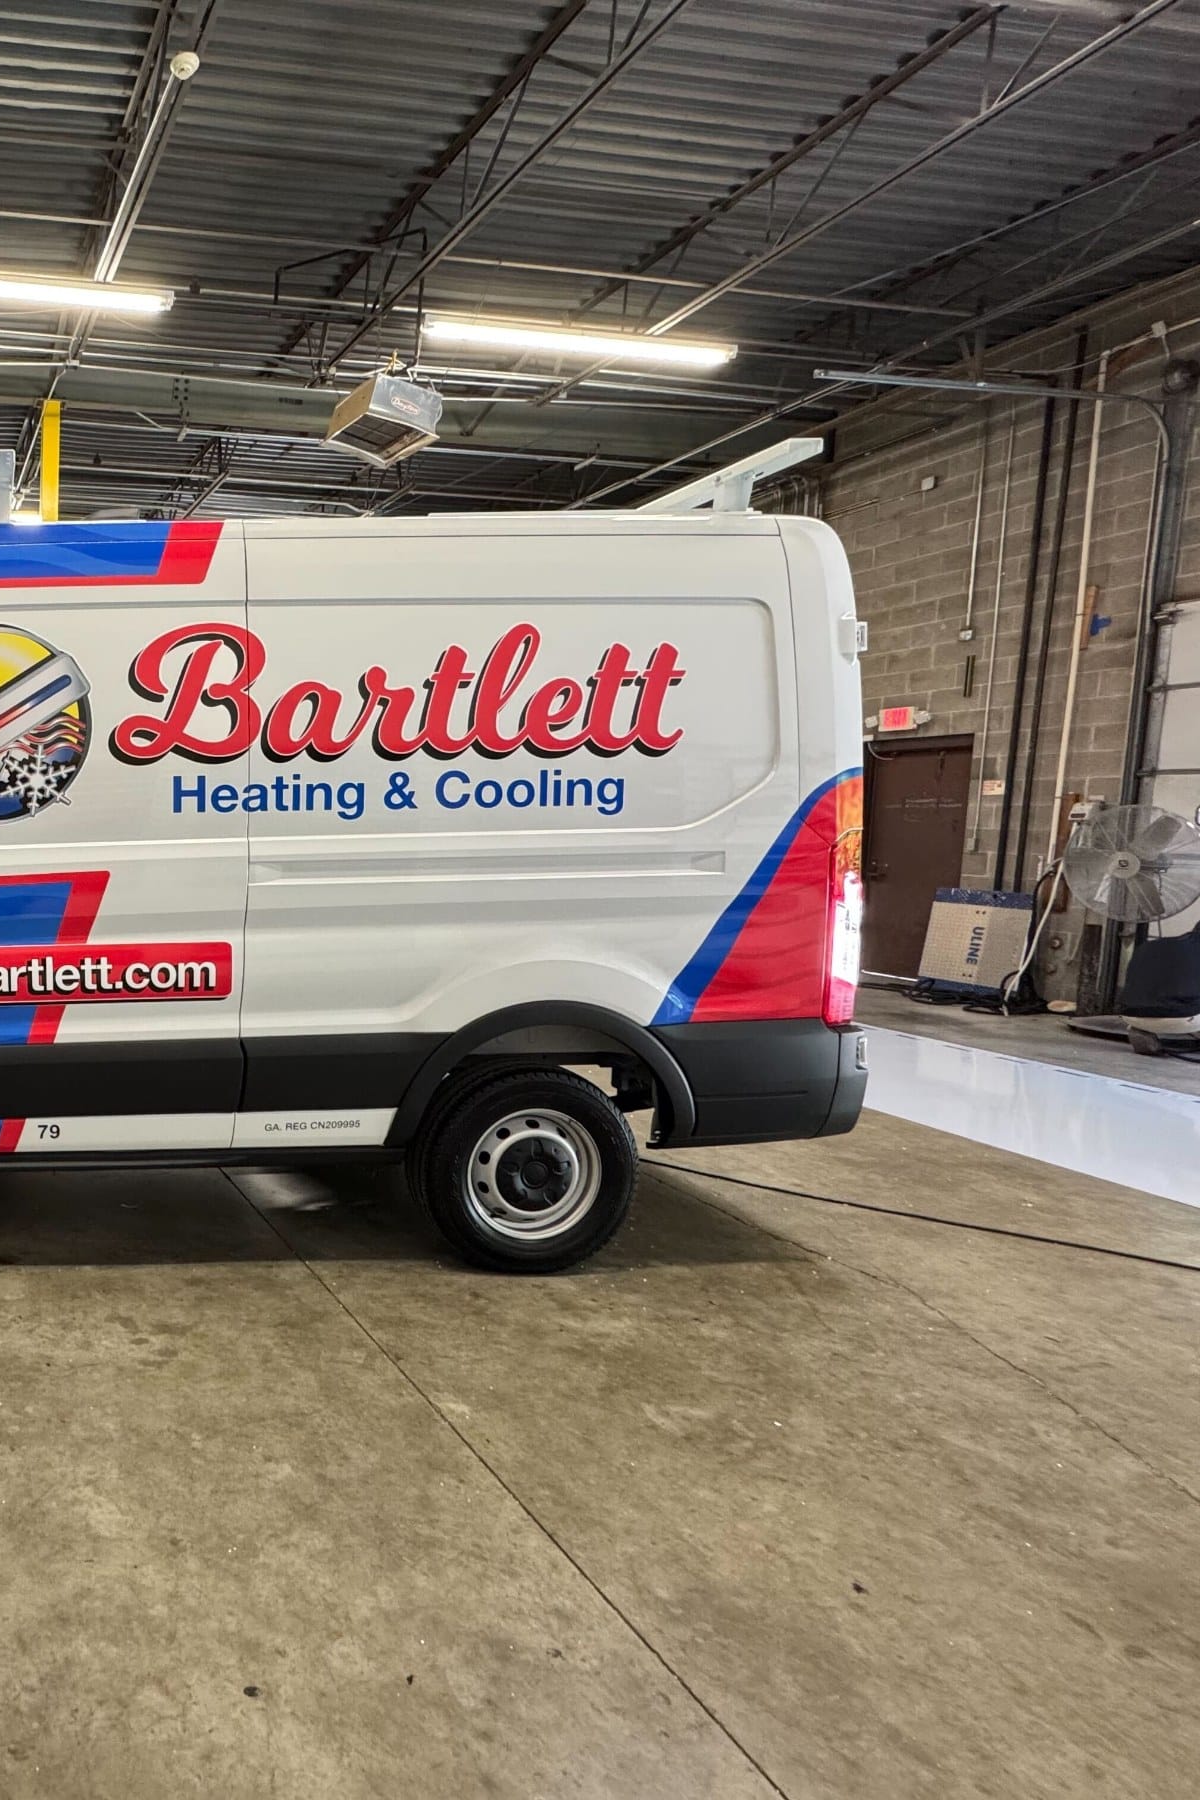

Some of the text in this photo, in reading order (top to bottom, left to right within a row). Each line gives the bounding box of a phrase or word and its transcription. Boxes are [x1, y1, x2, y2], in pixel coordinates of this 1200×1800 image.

[108, 622, 686, 765] Bartlett
[172, 769, 625, 819] Heating & Cooling
[966, 927, 986, 965] ULINE
[37, 1125, 60, 1139] 79
[264, 1120, 360, 1131] GA. REG CN209995
